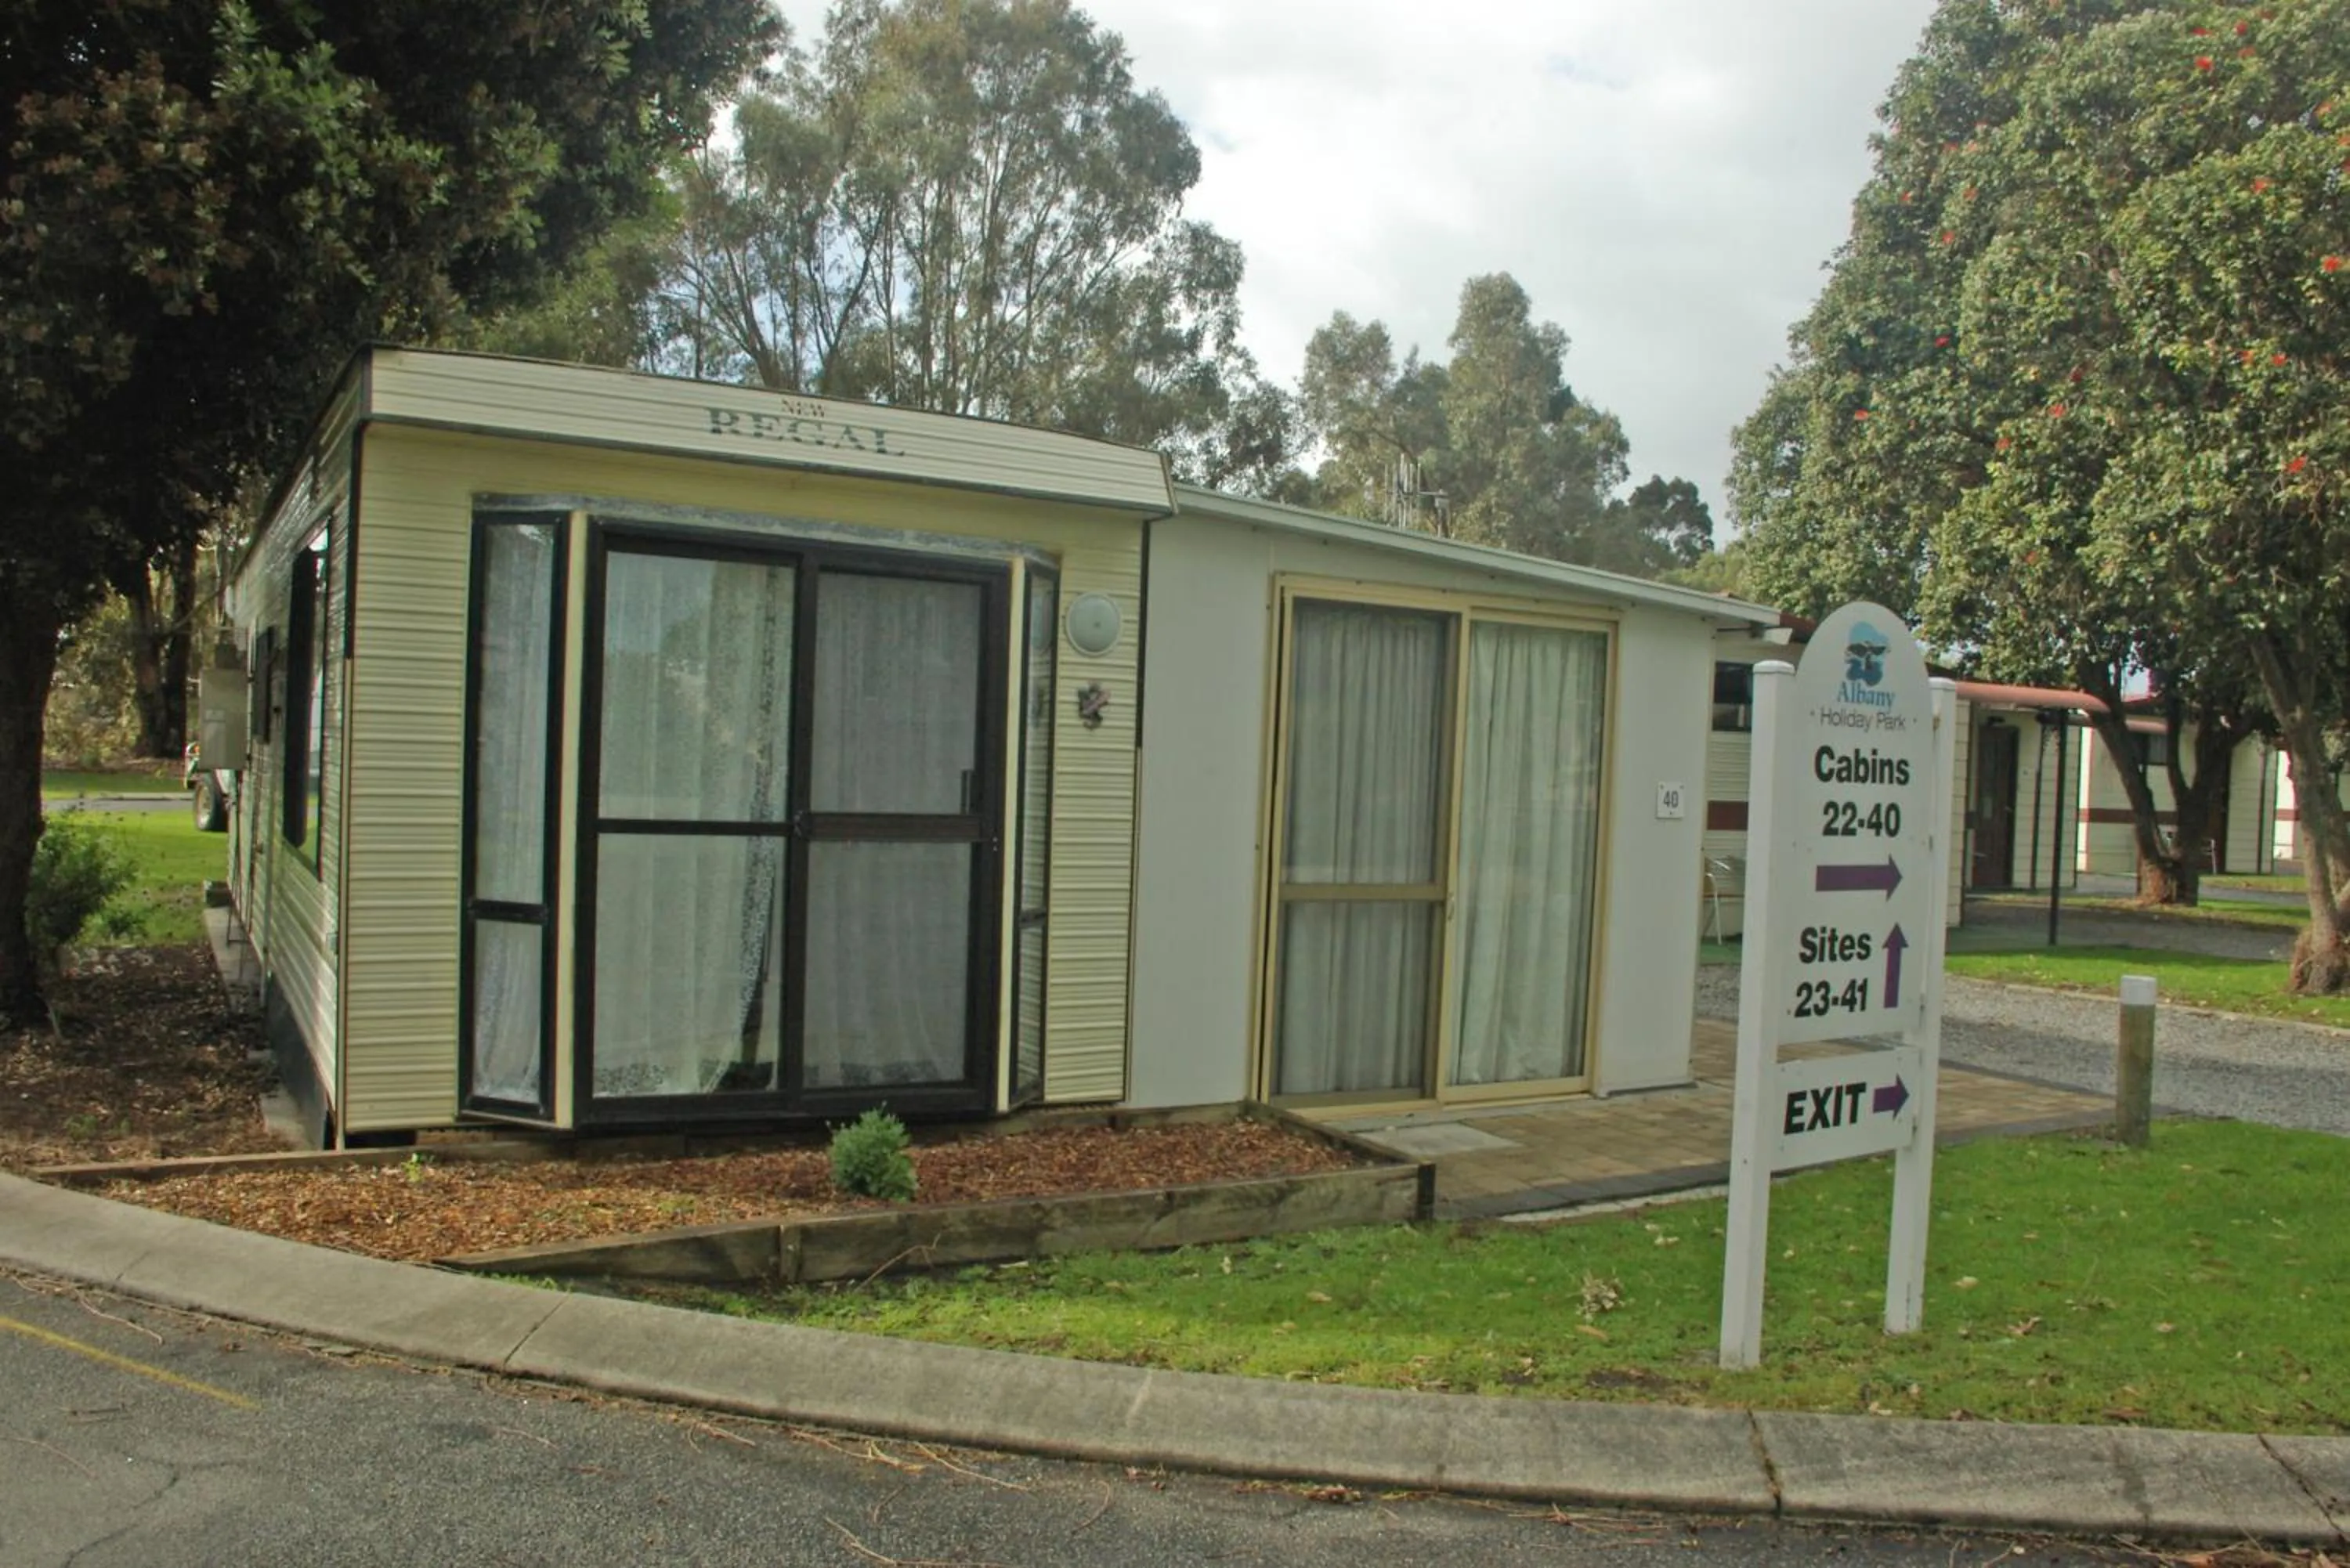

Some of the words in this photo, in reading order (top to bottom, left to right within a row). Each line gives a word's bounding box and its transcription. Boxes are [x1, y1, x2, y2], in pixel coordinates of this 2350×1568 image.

[706, 407, 906, 457] REGAL
[1837, 681, 1896, 710] Albany
[1820, 706, 1874, 732] Holiday
[1876, 712, 1906, 730] Park
[1814, 745, 1911, 786] Cabins
[1663, 790, 1679, 808] 40
[1821, 800, 1901, 837] 22-40
[1799, 926, 1872, 964] Sites
[1794, 977, 1868, 1018] 23-41
[1783, 1082, 1867, 1136] EXIT
